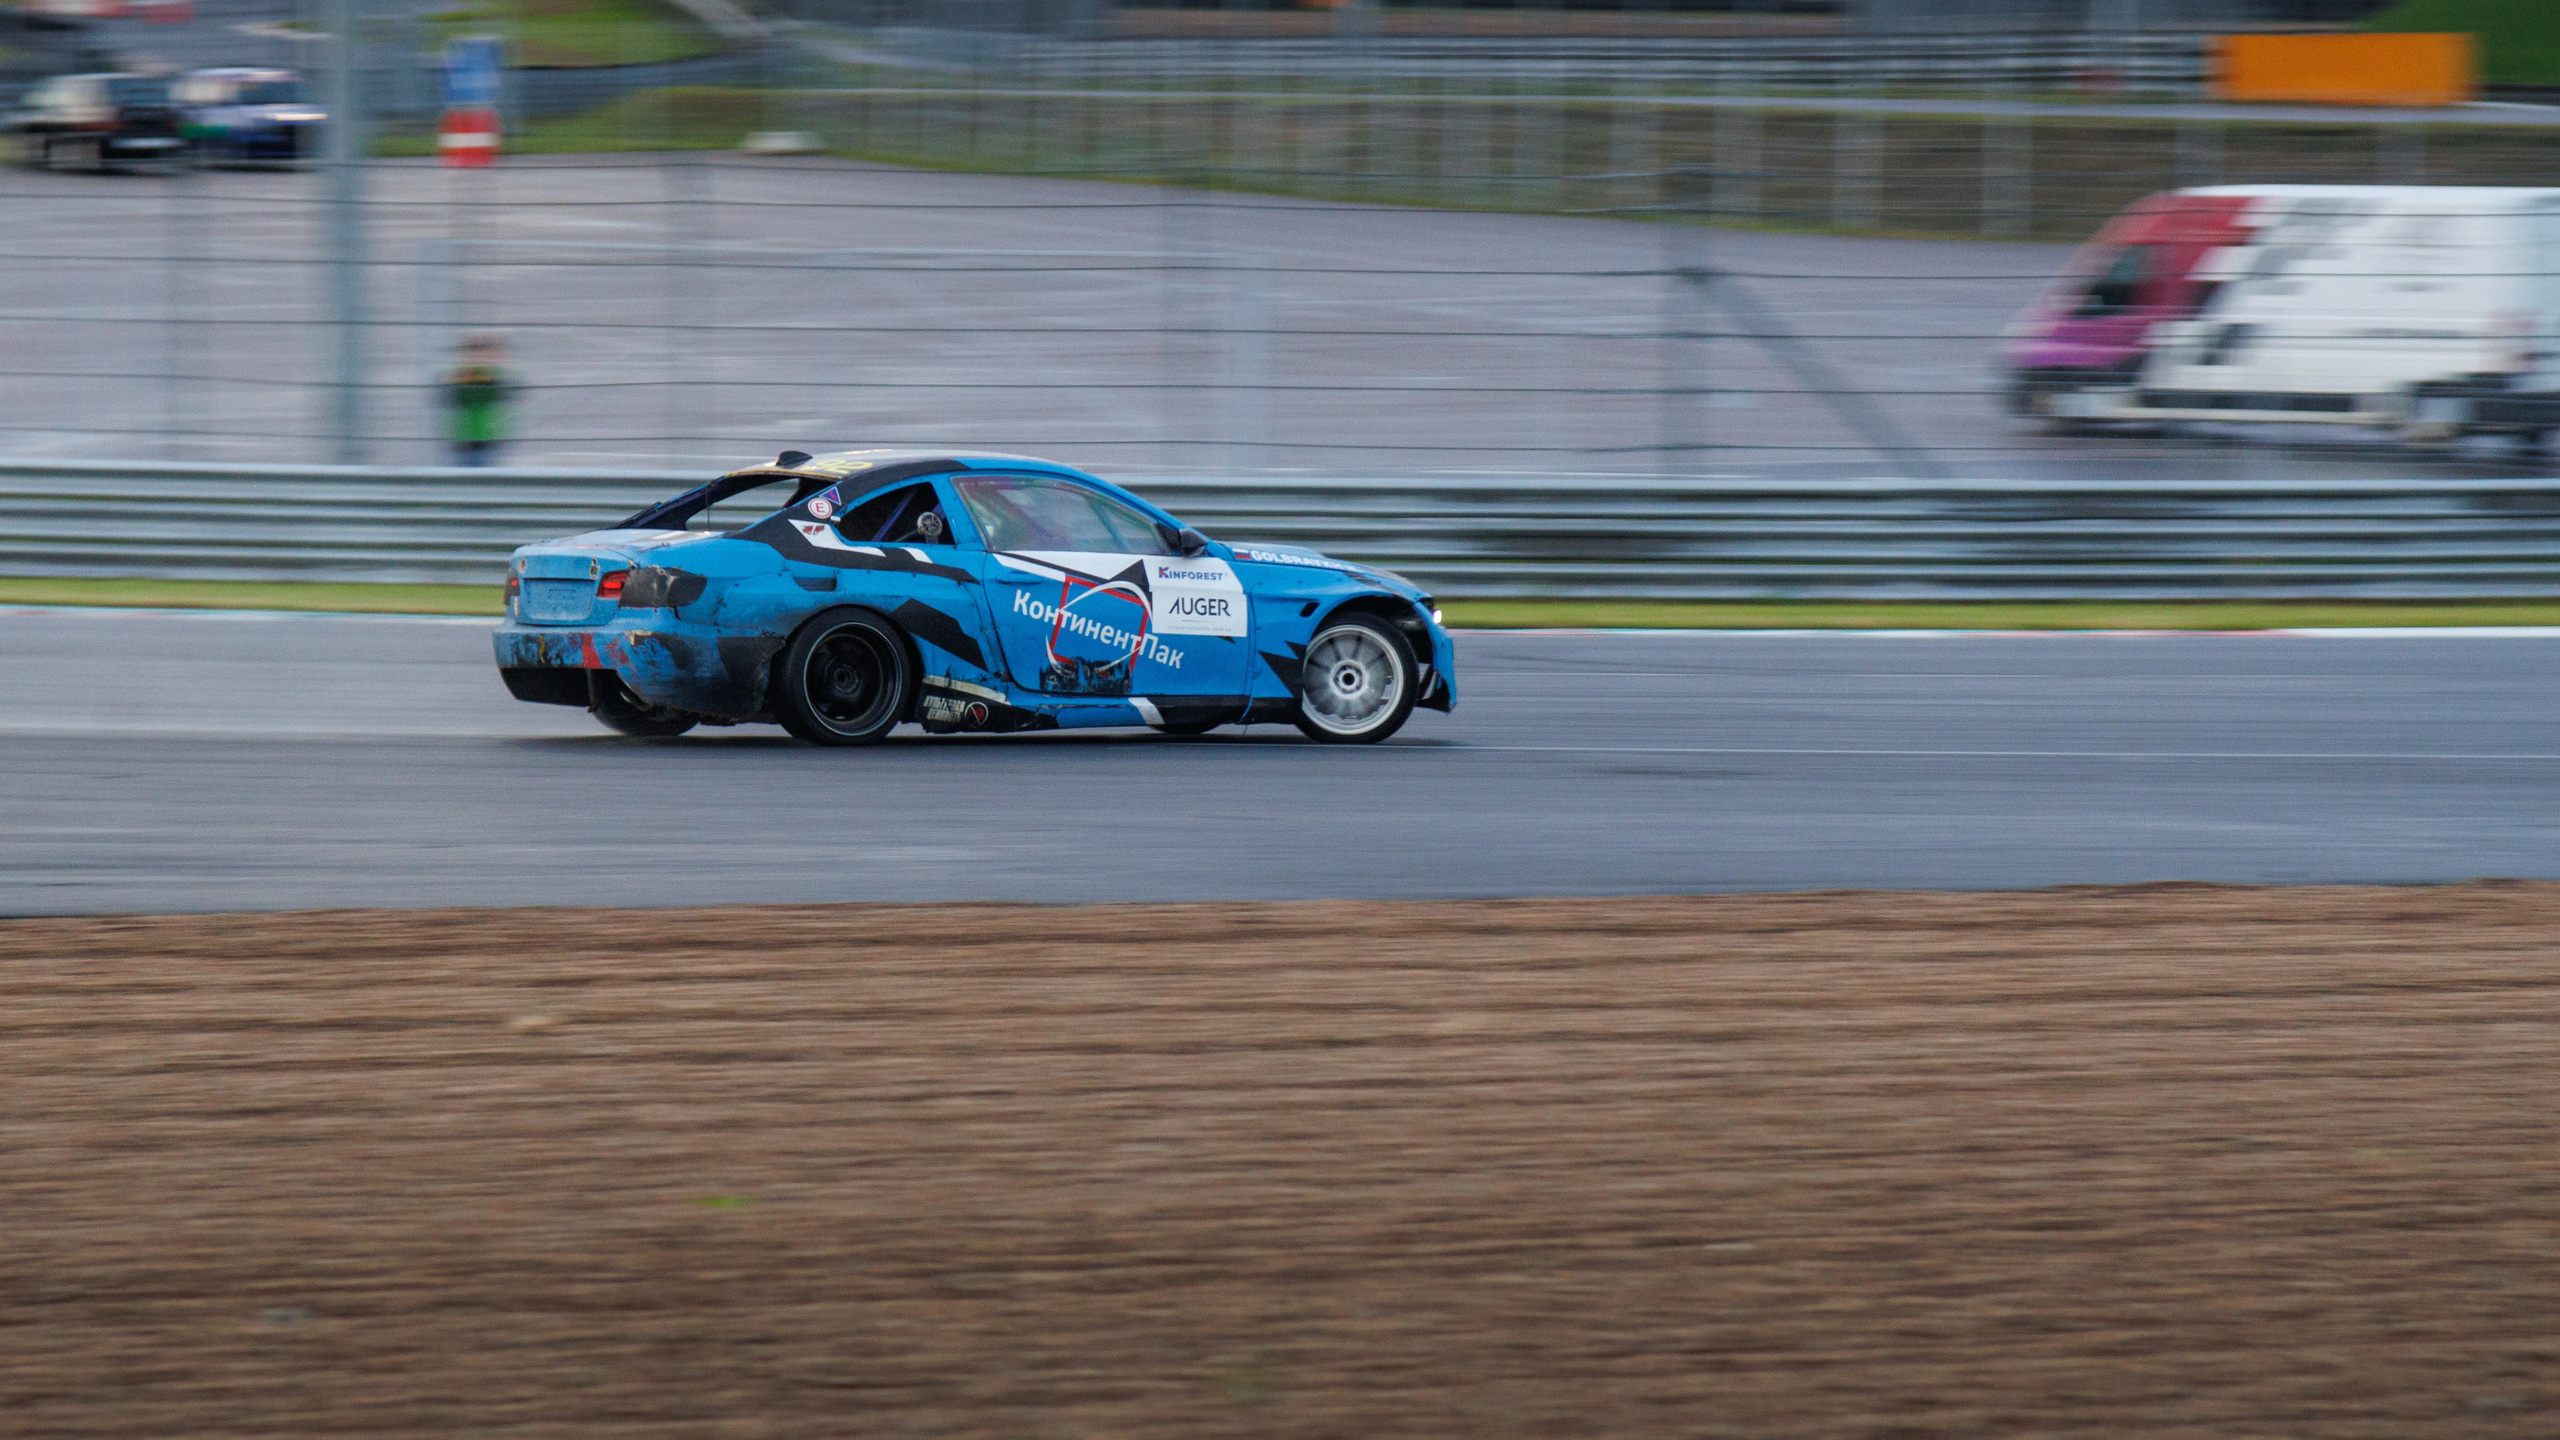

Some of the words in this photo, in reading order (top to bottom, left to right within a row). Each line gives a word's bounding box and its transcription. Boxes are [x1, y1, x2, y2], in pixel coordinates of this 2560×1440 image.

[815, 502, 826, 513] E
[1158, 566, 1224, 581] KINFOREST
[1168, 597, 1231, 617] AUGER
[1013, 589, 1184, 669] КонтинентПак
